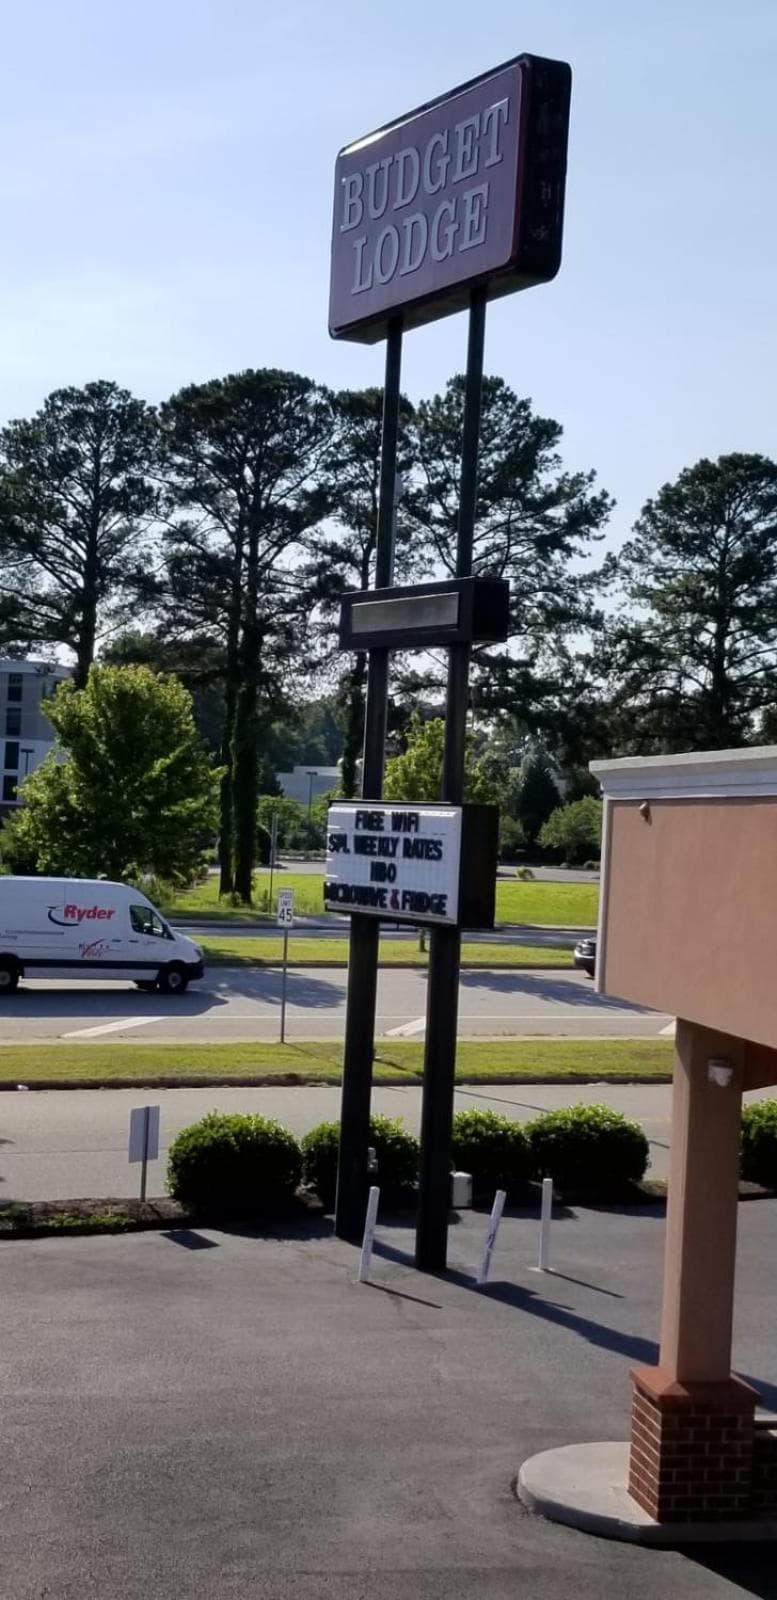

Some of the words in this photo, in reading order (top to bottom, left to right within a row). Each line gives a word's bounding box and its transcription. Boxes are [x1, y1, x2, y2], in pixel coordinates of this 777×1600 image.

[340, 97, 510, 233] BUDGET
[351, 182, 489, 295] LODGE
[355, 810, 385, 831] FREE
[391, 811, 420, 833] WIFI
[353, 834, 399, 858] WEEKLY
[402, 837, 443, 861] RATES
[370, 861, 397, 883] HBO
[63, 904, 115, 922] Ryder
[279, 907, 292, 922] 45
[402, 890, 448, 916] FRIDGE
